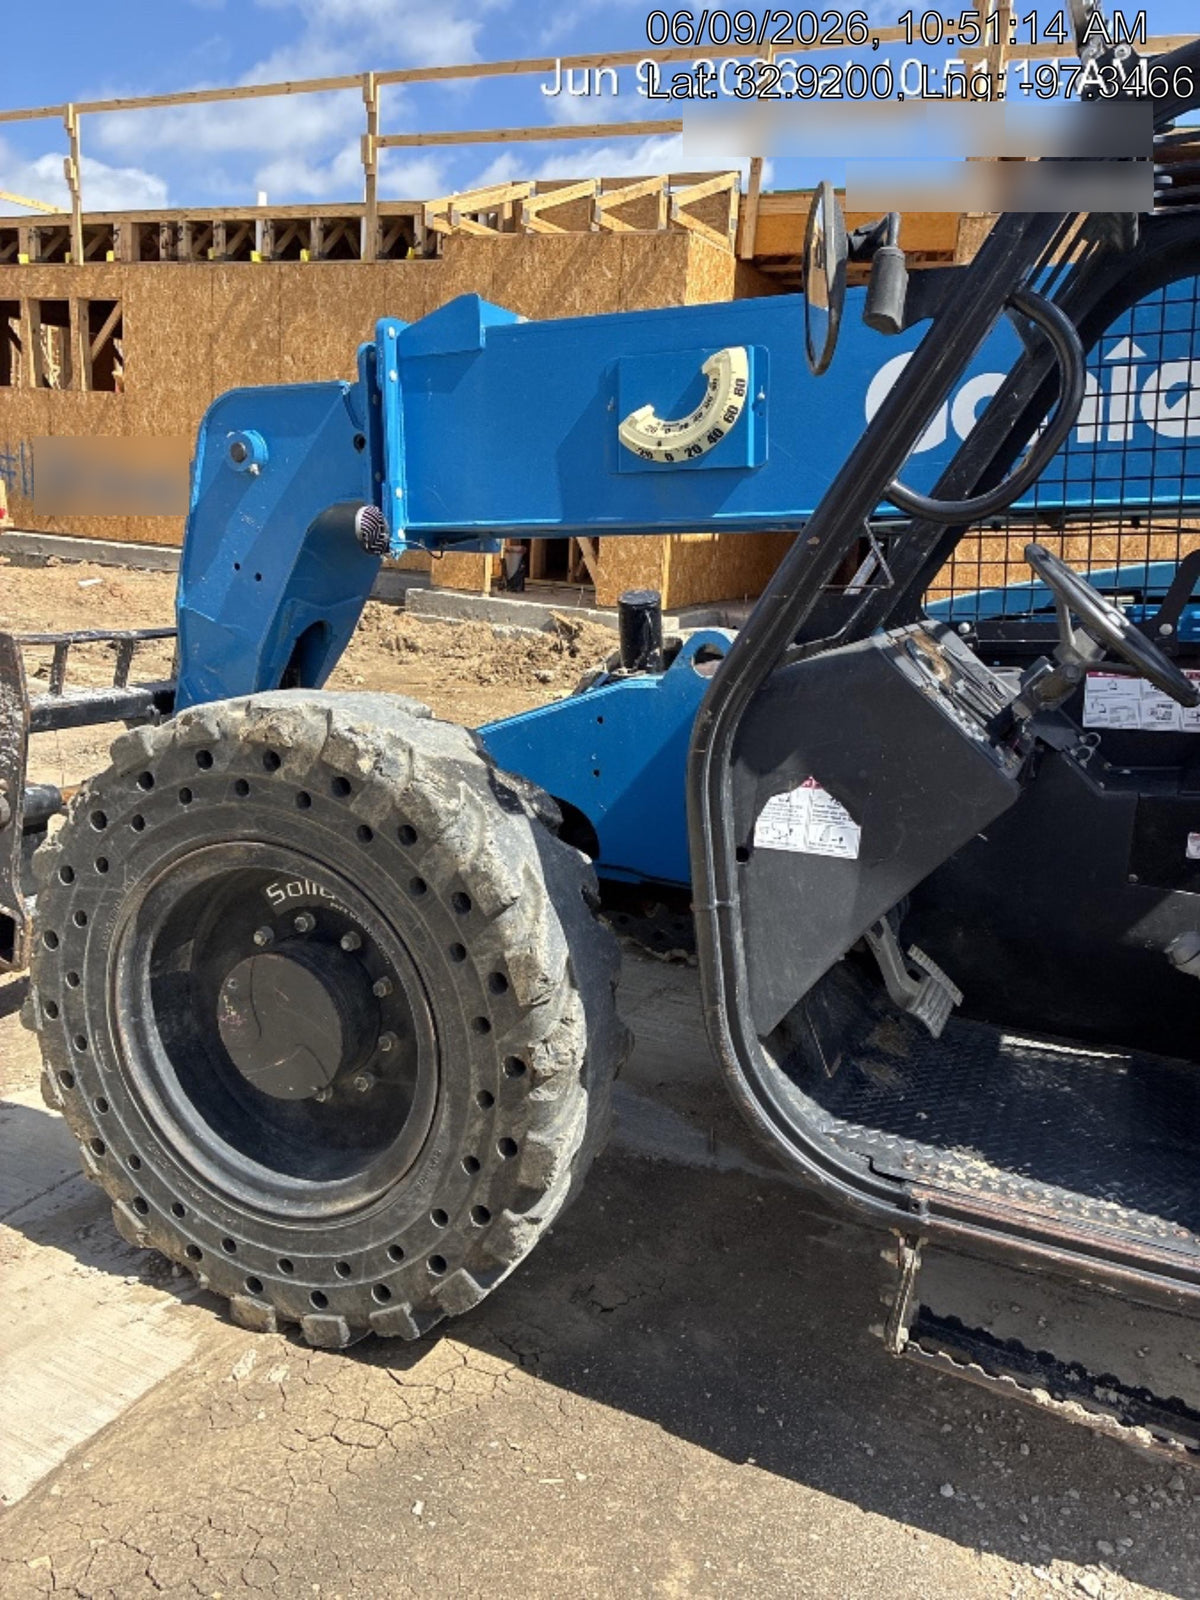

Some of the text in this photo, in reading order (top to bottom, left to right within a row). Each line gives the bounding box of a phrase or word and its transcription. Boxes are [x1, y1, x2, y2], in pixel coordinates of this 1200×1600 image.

[684, 443, 703, 459] 20
[706, 427, 724, 445] 40
[723, 404, 739, 424] 60
[733, 377, 746, 397] 80
